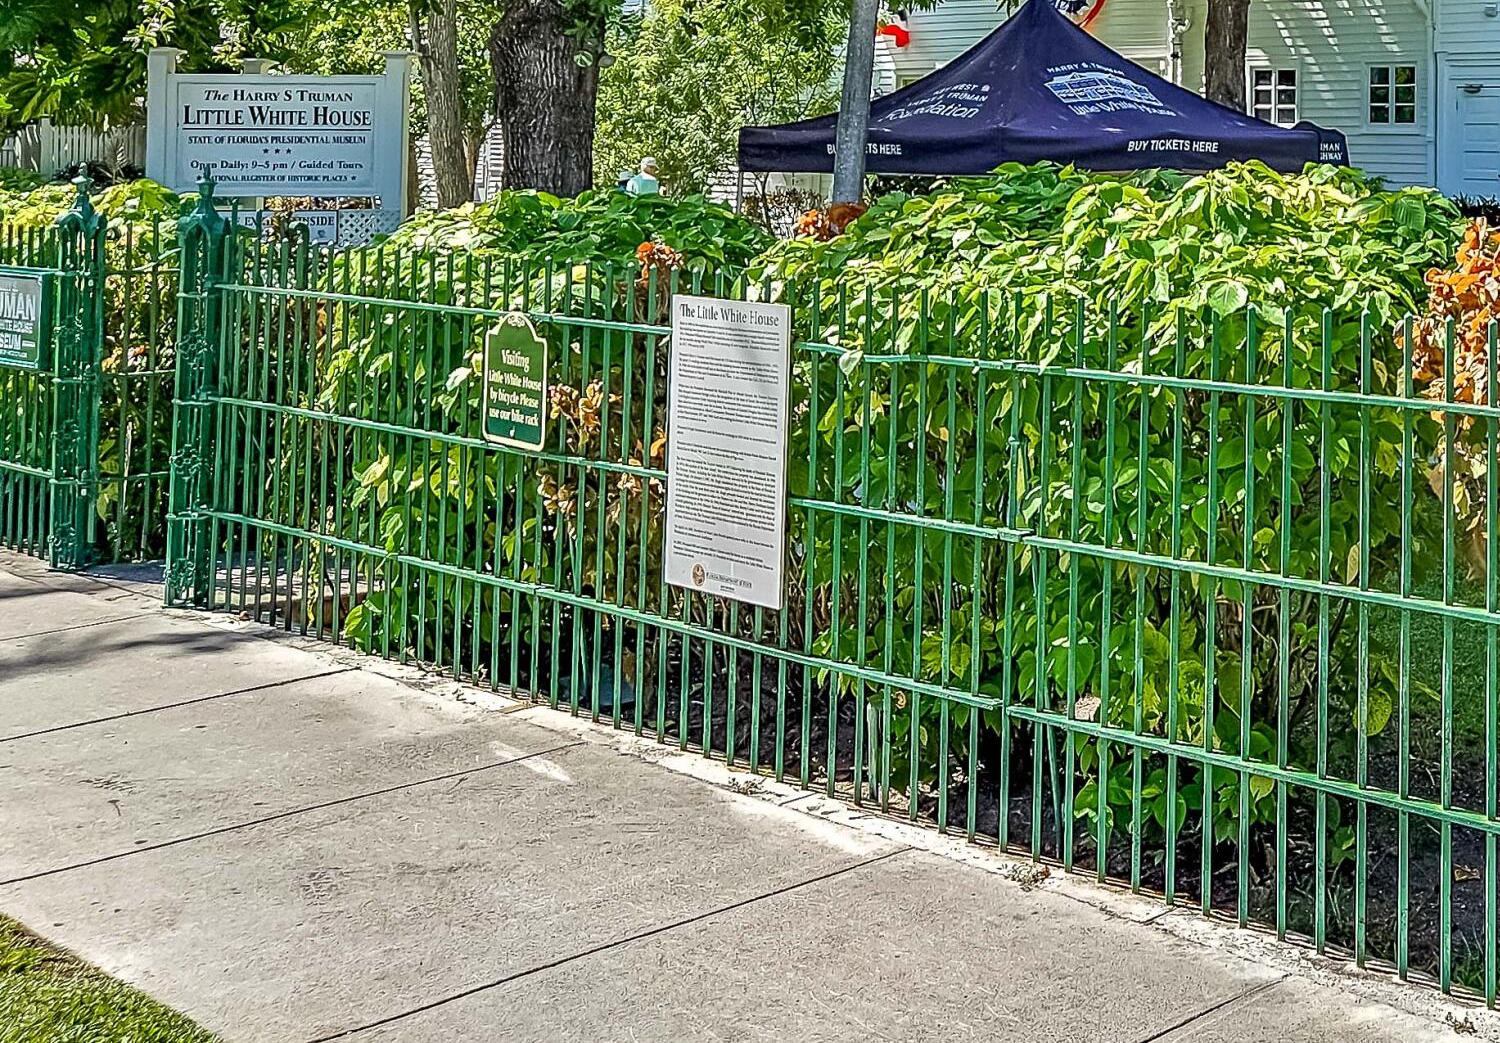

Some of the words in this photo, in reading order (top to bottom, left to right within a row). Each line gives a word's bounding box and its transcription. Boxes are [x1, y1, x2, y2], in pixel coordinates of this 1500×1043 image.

[204, 89, 229, 101] The
[233, 89, 280, 102] HARRY
[284, 90, 291, 102] S
[296, 90, 353, 102] TRUMAN
[947, 92, 988, 102] TRUMAN
[183, 105, 244, 125] LITTLE
[247, 105, 307, 126] WHITE
[313, 106, 371, 126] HOUSE
[188, 136, 211, 144] STATE
[214, 136, 226, 144] OF
[270, 136, 330, 144] PRESIDENTIAL
[332, 136, 366, 144] MUSEUM
[1128, 140, 1149, 152] BUY
[1150, 139, 1190, 151] TICKETS
[1192, 141, 1219, 152] HERE
[879, 144, 902, 155] HERE
[272, 163, 288, 172] pm
[298, 160, 334, 170] Guided
[336, 161, 363, 170] Tours
[680, 303, 695, 318] The
[697, 305, 718, 320] Little
[720, 308, 747, 323] White
[749, 310, 779, 326] House
[501, 349, 530, 373] Visiting
[489, 369, 504, 384] Little
[504, 372, 522, 387] White
[522, 376, 542, 392] House
[490, 387, 499, 403] by
[498, 388, 519, 406] bicycle
[519, 393, 539, 408] Please
[511, 408, 524, 423] bike
[525, 414, 539, 427] rack
